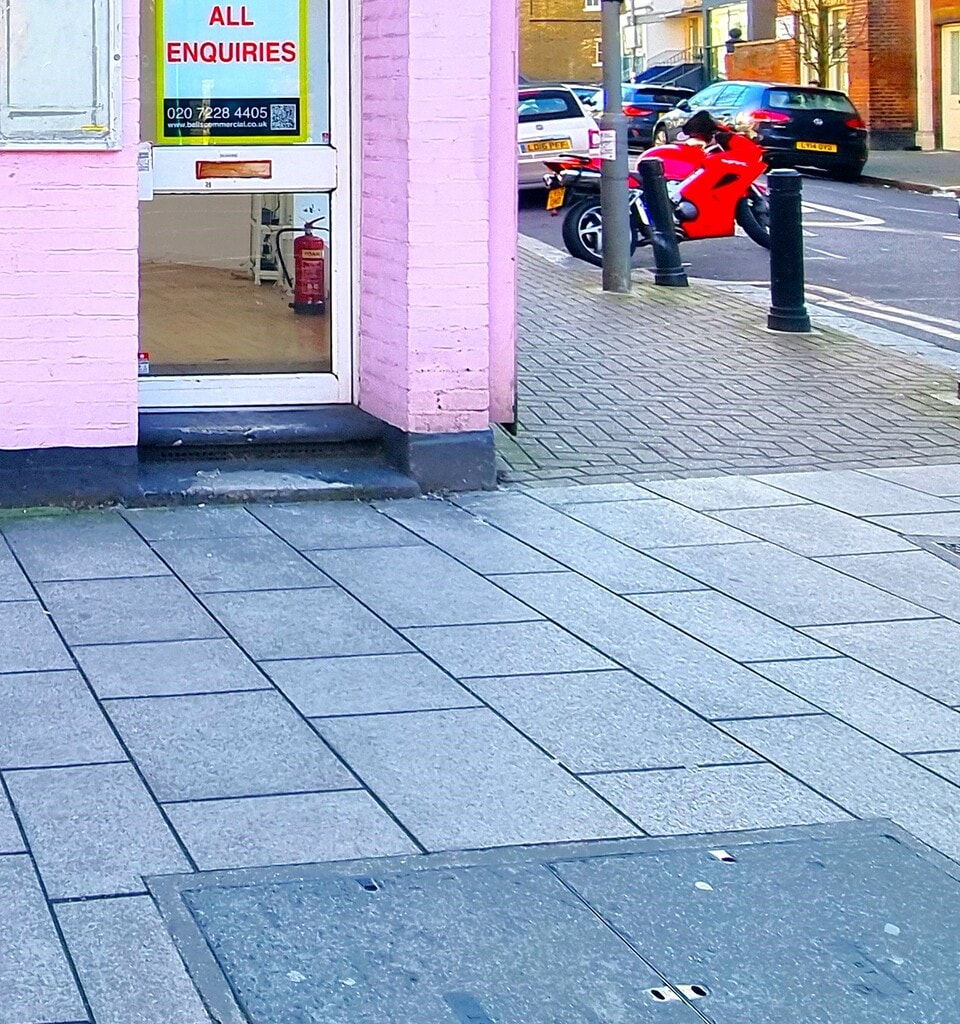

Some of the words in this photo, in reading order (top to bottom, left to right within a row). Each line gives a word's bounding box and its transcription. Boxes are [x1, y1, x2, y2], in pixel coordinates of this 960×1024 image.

[208, 5, 254, 27] ALL
[167, 42, 297, 64] ENQUIRIES
[167, 107, 193, 120] 020
[196, 107, 230, 120] 7228
[234, 106, 268, 119] 4405
[167, 120, 268, 128] www.bellscommercial.co.uk
